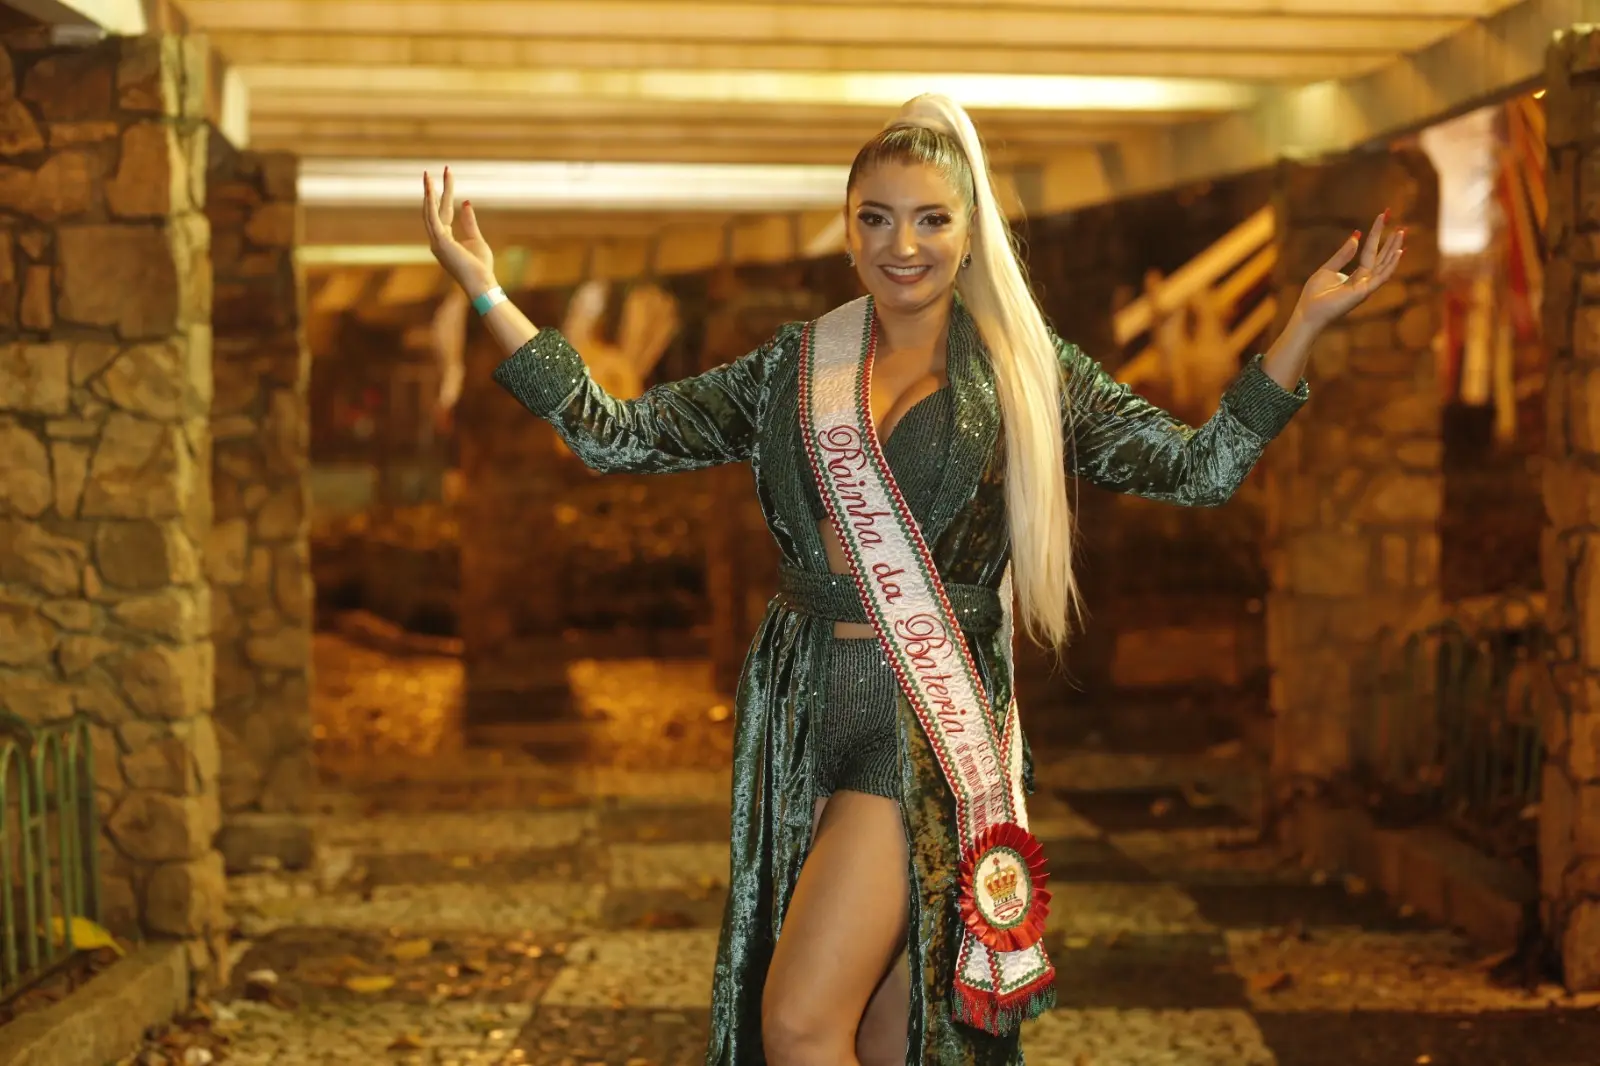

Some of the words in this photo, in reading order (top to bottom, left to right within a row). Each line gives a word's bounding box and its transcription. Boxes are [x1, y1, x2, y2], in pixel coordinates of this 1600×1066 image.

[818, 424, 891, 549] Rainha
[872, 562, 904, 604] da
[895, 613, 967, 738] Bateria
